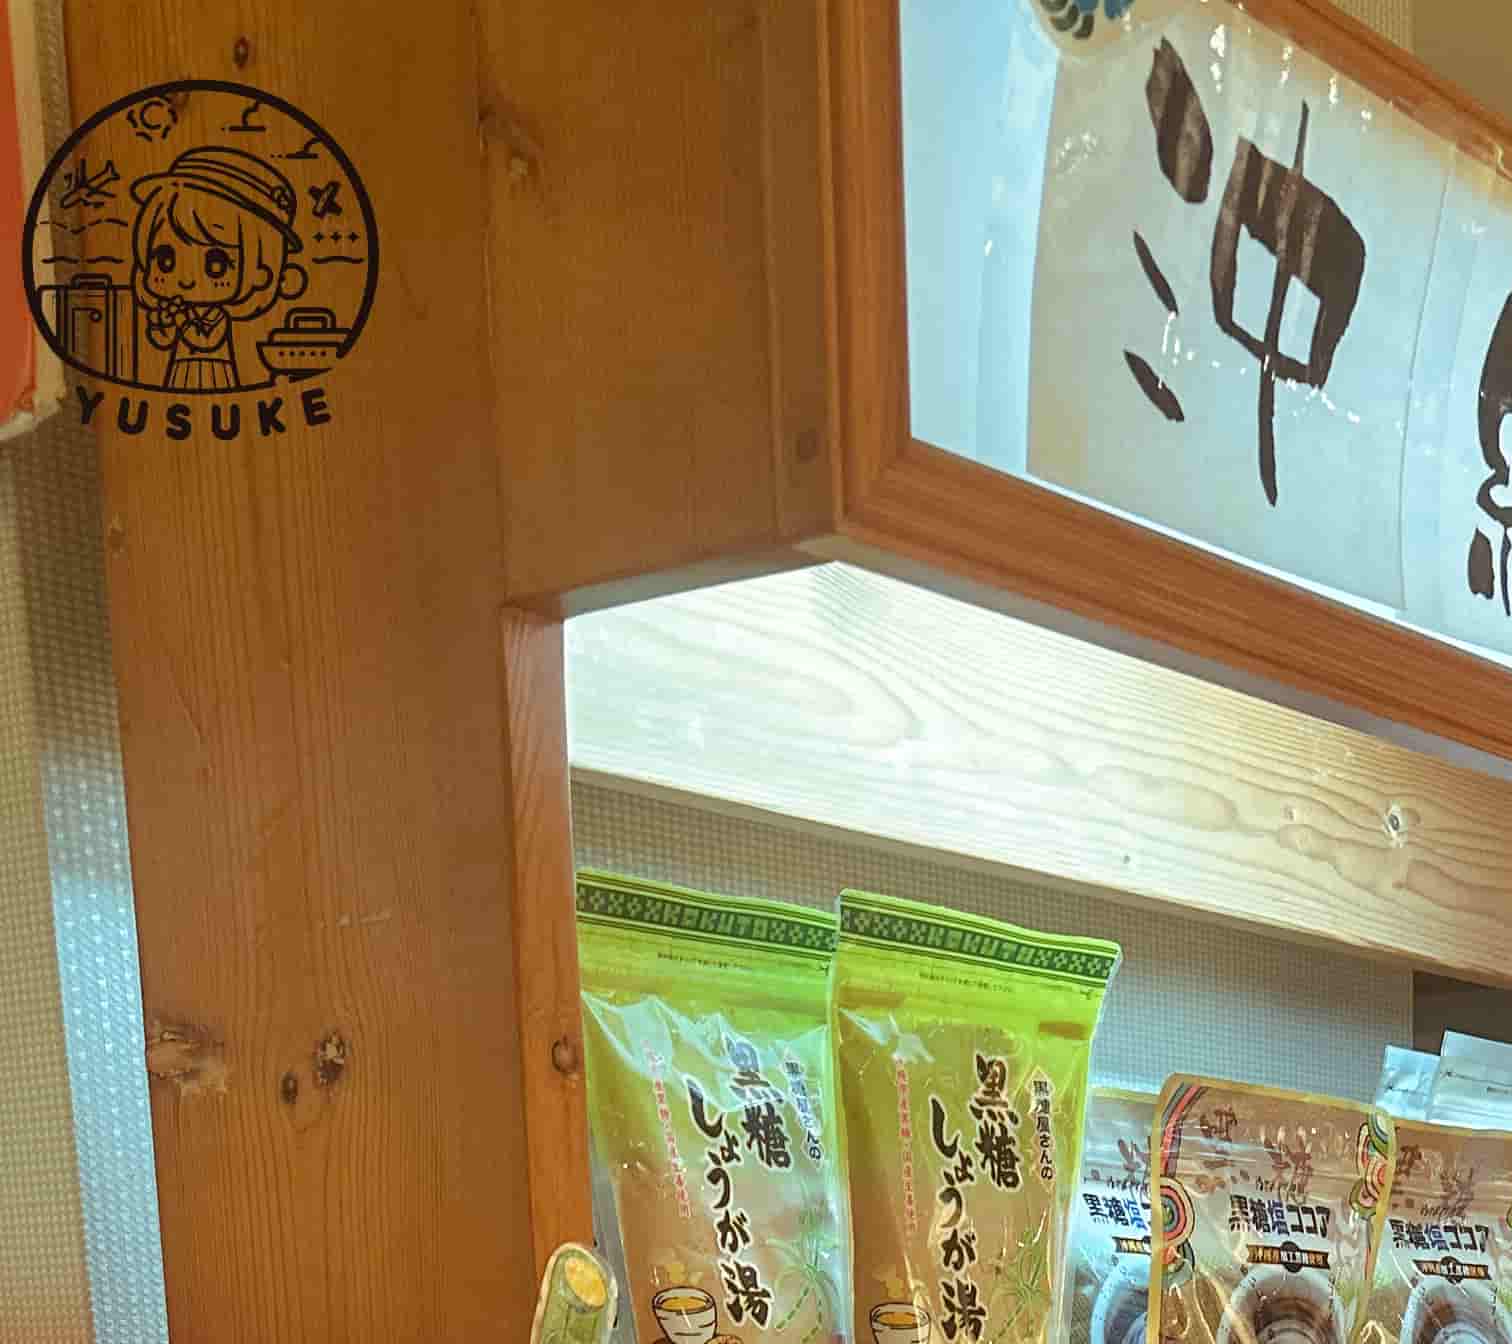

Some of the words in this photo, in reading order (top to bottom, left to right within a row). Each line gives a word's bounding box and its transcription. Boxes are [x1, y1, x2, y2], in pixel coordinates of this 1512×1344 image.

[684, 1074, 772, 1327] しょうが湯
[970, 1052, 1021, 1189] 黒糖
[1229, 1194, 1331, 1238] 黒糖塩ココア
[928, 1094, 986, 1343] しょうが湯
